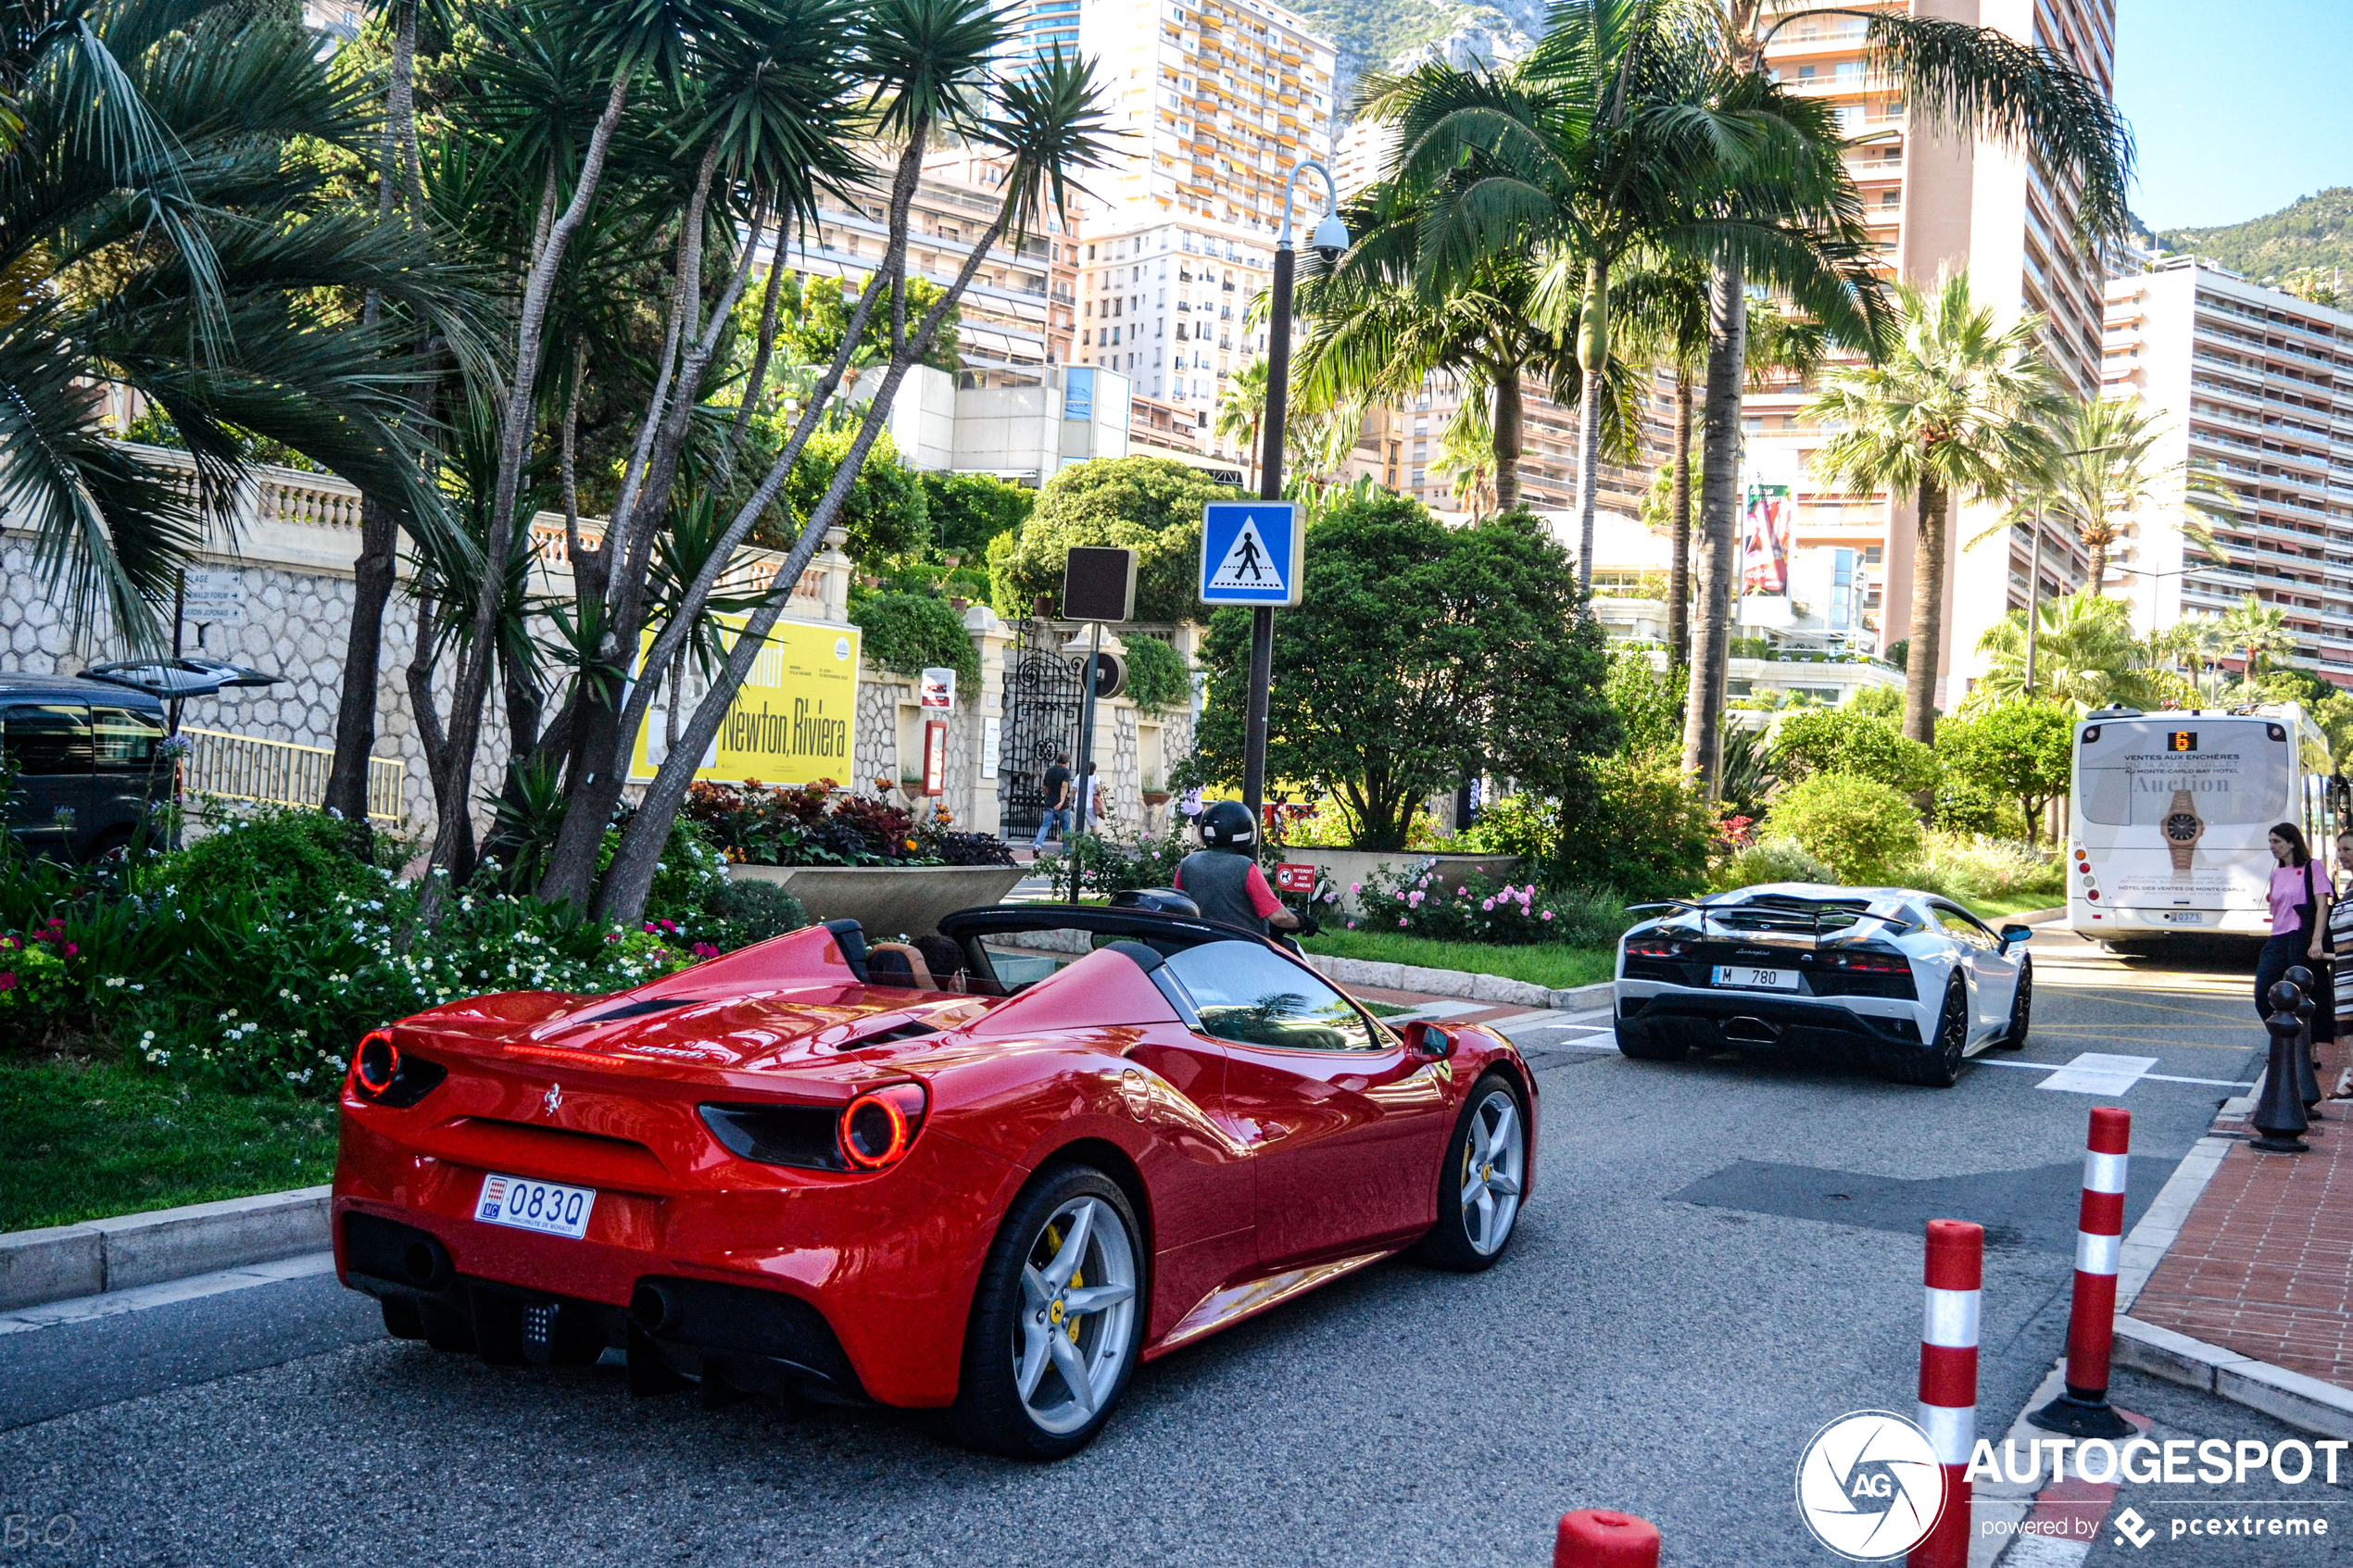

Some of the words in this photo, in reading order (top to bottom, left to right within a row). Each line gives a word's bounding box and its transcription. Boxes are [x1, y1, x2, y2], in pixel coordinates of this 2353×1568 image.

[723, 700, 790, 758] Newton,
[792, 697, 847, 758] Riviera
[2175, 731, 2188, 751] 6
[2135, 776, 2229, 793] Auction
[1722, 968, 1732, 982] M
[1752, 970, 1777, 985] 780
[484, 1203, 497, 1216] MC
[550, 1223, 573, 1233] MONACO
